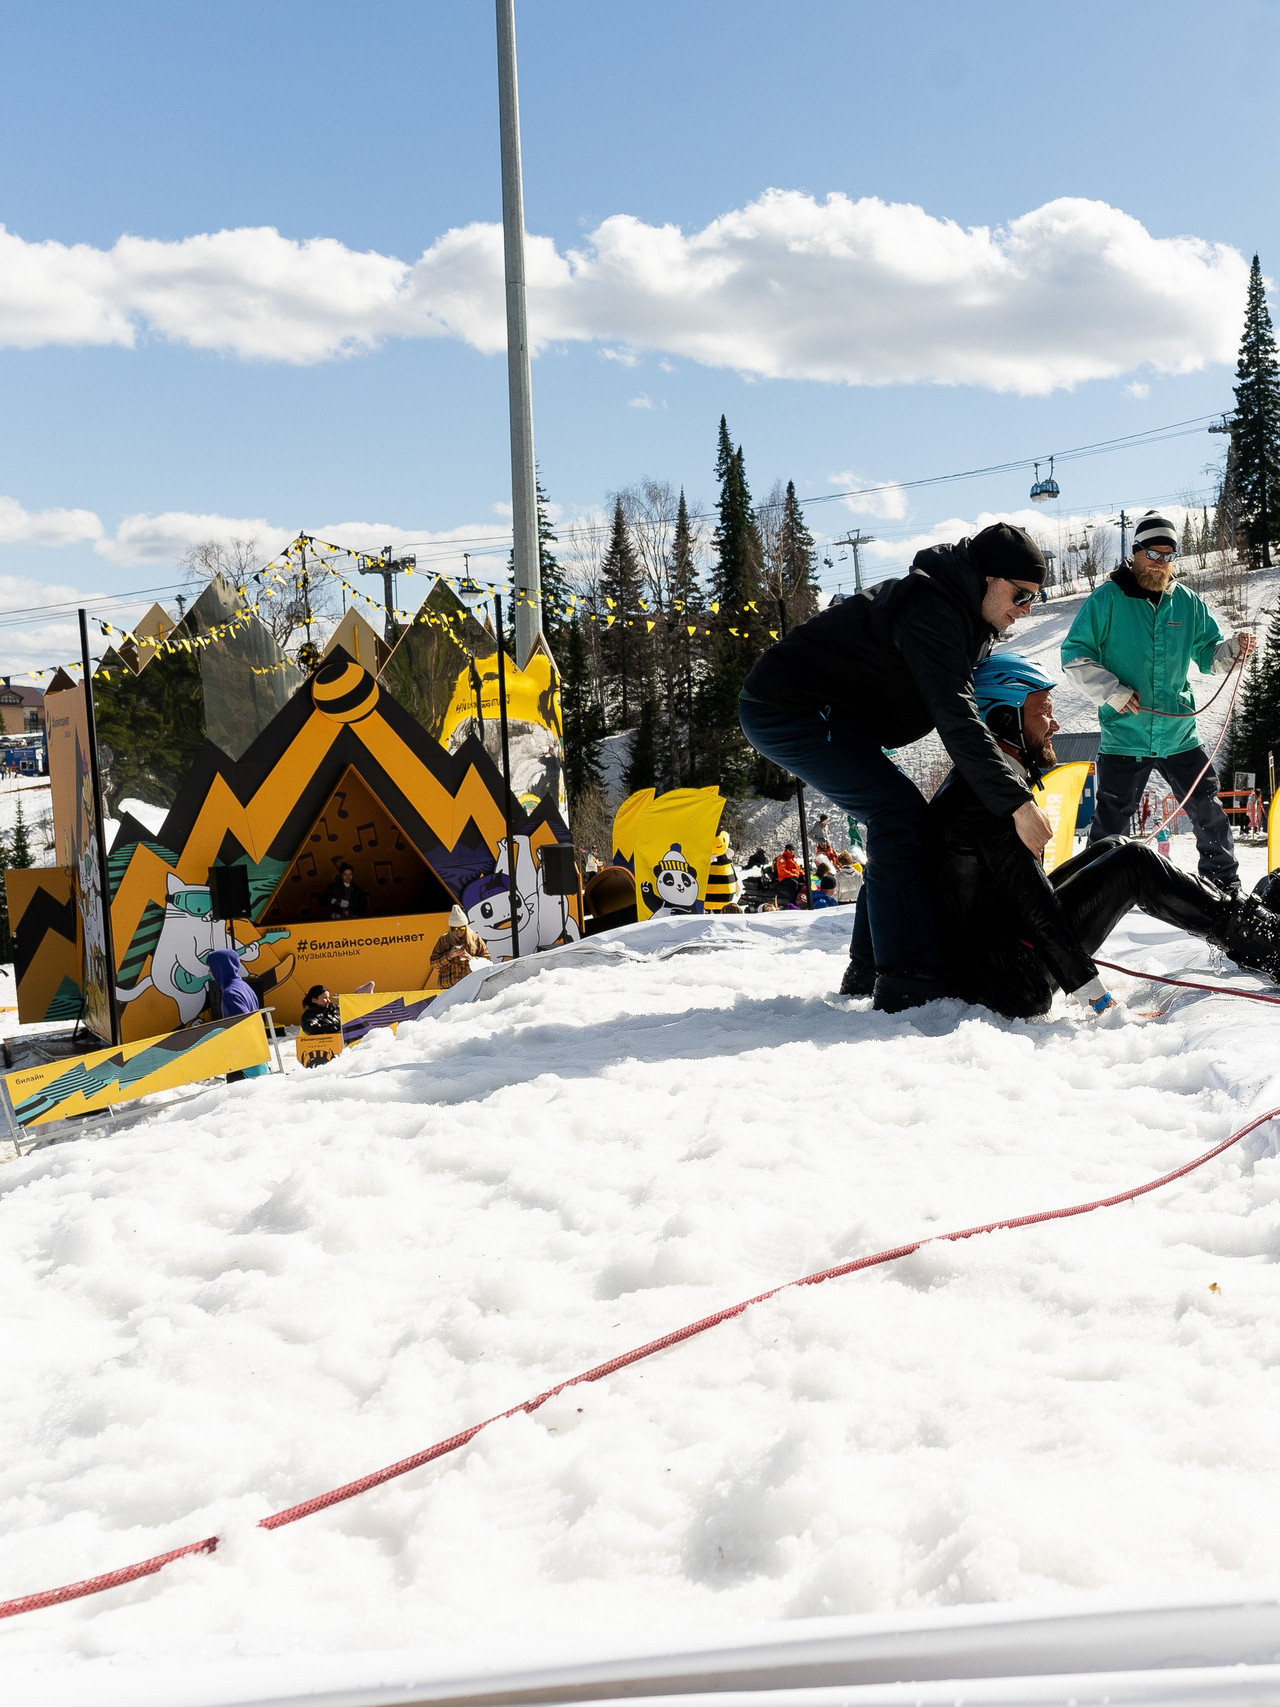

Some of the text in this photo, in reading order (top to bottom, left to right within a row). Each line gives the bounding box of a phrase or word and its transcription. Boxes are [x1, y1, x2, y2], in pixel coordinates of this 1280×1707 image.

[297, 933, 425, 952] #билайнсоединяет
[297, 948, 361, 962] музыкальных
[15, 1074, 45, 1085] билайн
